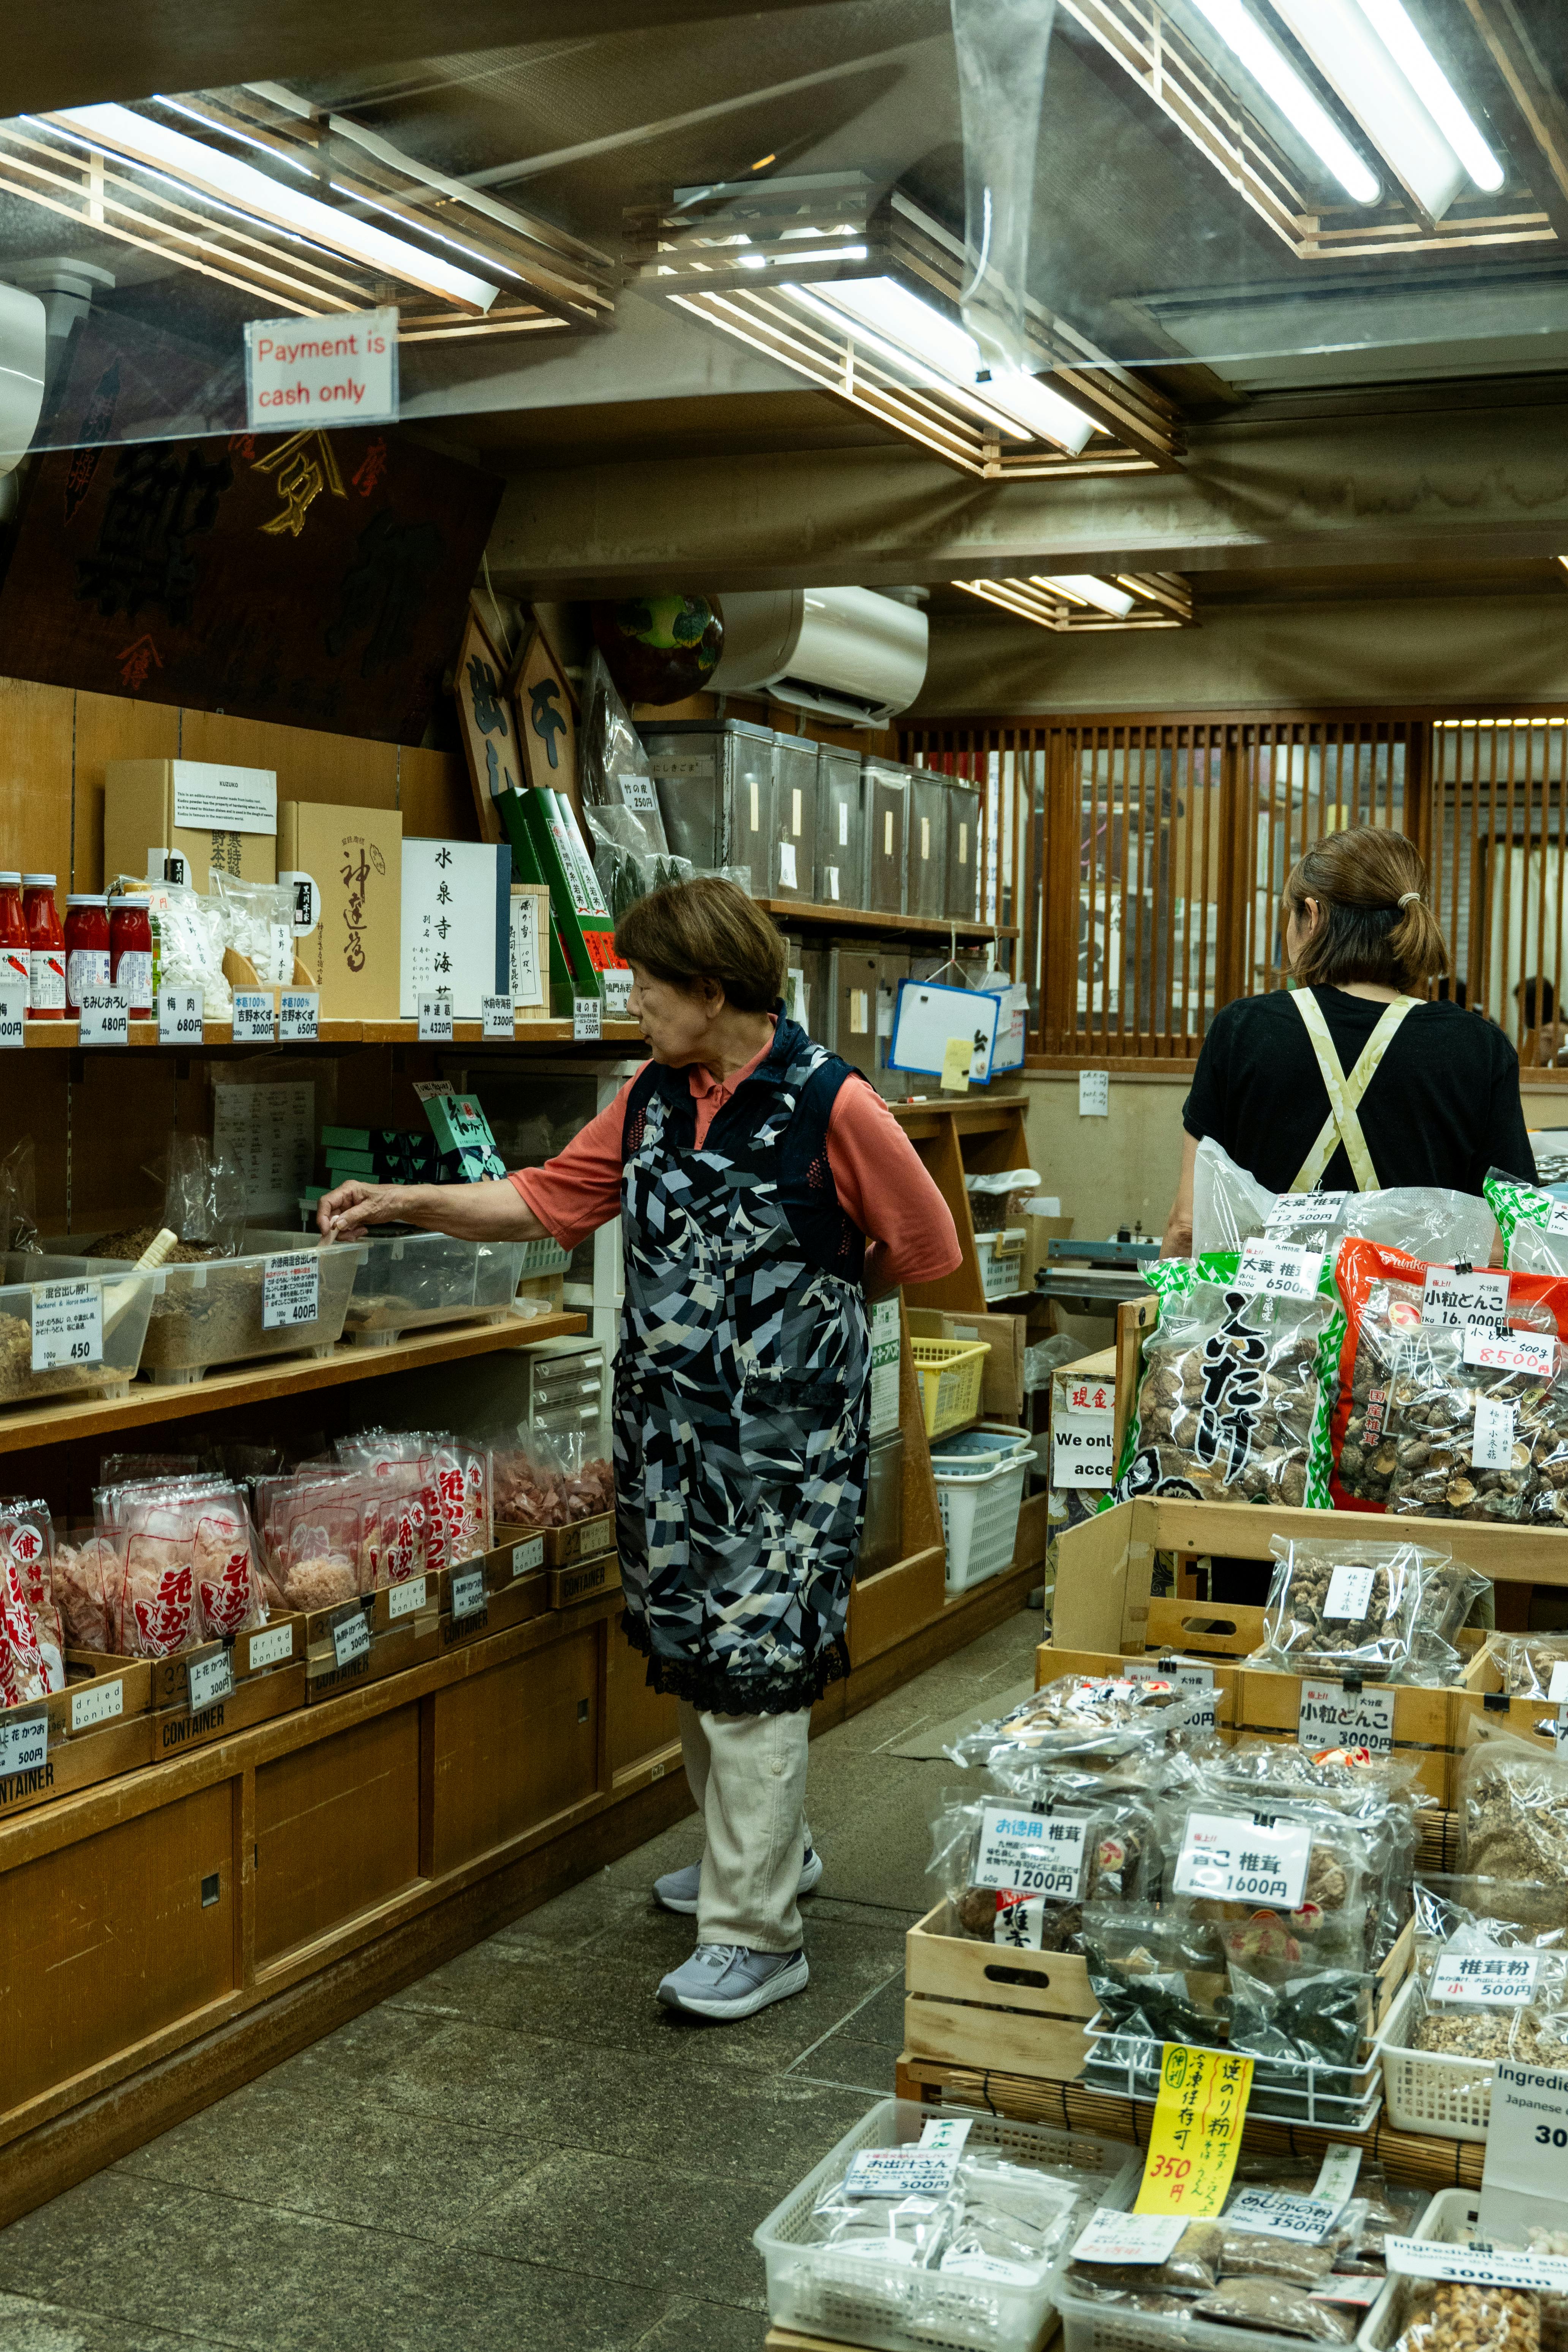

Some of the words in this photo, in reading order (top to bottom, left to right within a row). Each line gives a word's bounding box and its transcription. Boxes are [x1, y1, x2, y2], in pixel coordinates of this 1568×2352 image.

[258, 334, 358, 364] Payment
[367, 330, 386, 354] is
[259, 381, 310, 407] cash
[319, 378, 366, 405] only
[624, 784, 647, 793] 竹の皮
[634, 797, 653, 807] 250円
[104, 958, 110, 980] 梅肉
[82, 996, 128, 1009] もみじおろし
[236, 996, 266, 1007] 本葛100%
[282, 997, 310, 1007] 本葛100%
[484, 997, 511, 1009] 水前寺海苔
[101, 1018, 126, 1031] 480円
[238, 1010, 272, 1022] 吉野本くず
[281, 1010, 315, 1022] 吉野本くず
[493, 1016, 513, 1026] 2300円
[177, 1019, 202, 1032] 680円
[252, 1023, 274, 1035] 3000円
[297, 1023, 318, 1035] 650円
[430, 1022, 451, 1033] 4320円
[585, 1024, 599, 1034] 550円
[1278, 1199, 1309, 1208] 大葉
[1276, 1214, 1332, 1222] 12.500円
[1275, 1244, 1301, 1253] 九州特産
[1243, 1258, 1276, 1273] 大葉
[79, 1296, 98, 1304] mackerel
[1424, 1290, 1503, 1311] 小粒どんこ
[293, 1304, 316, 1320] 400円
[71, 1342, 90, 1358] 450
[1519, 1344, 1548, 1359] 500g
[1072, 1386, 1115, 1409] 現金
[1362, 1389, 1386, 1446] 国産椎茸
[1056, 1433, 1082, 1446] We
[515, 1542, 542, 1560] dried
[515, 1555, 542, 1572] bonito
[392, 1582, 424, 1602] dried
[468, 1592, 483, 1606] 500円
[392, 1597, 424, 1614] bonito
[253, 1630, 289, 1650] dried
[351, 1633, 368, 1650] 300円
[253, 1646, 290, 1664] bonito
[210, 1678, 229, 1696] 300円
[1181, 1676, 1203, 1685] 大分産
[76, 1687, 119, 1709] dried
[1360, 1698, 1383, 1707] 大分産
[76, 1703, 120, 1725] bonito
[1300, 1702, 1388, 1729] 小粒どんこ
[163, 1704, 224, 1748] CONTAINER
[1339, 1731, 1391, 1751] 3000円
[18, 1747, 43, 1764] 500円
[996, 1819, 1043, 1838] お徳用
[1049, 1823, 1081, 1842] 椎茸
[1239, 1851, 1281, 1875] 椎茸
[1013, 1869, 1073, 1892] 1200円
[1227, 1875, 1287, 1897] 1600円
[1459, 1958, 1530, 1976] 椎茸粉
[1447, 1983, 1463, 1994] 小
[1481, 1984, 1531, 1996] 500円
[1173, 2053, 1206, 2151] 冷凍保存可
[1208, 2058, 1241, 2138] 焼のり粉
[1506, 2094, 1562, 2114] Japanese
[1535, 2124, 1568, 2148] 30
[867, 2160, 948, 2169] お出汁さん
[1150, 2154, 1192, 2179] 350
[899, 2180, 949, 2189] 500円
[1170, 2184, 1185, 2203] 円
[1268, 2216, 1326, 2235] 350円
[1393, 2241, 1504, 2262] Ingredients
